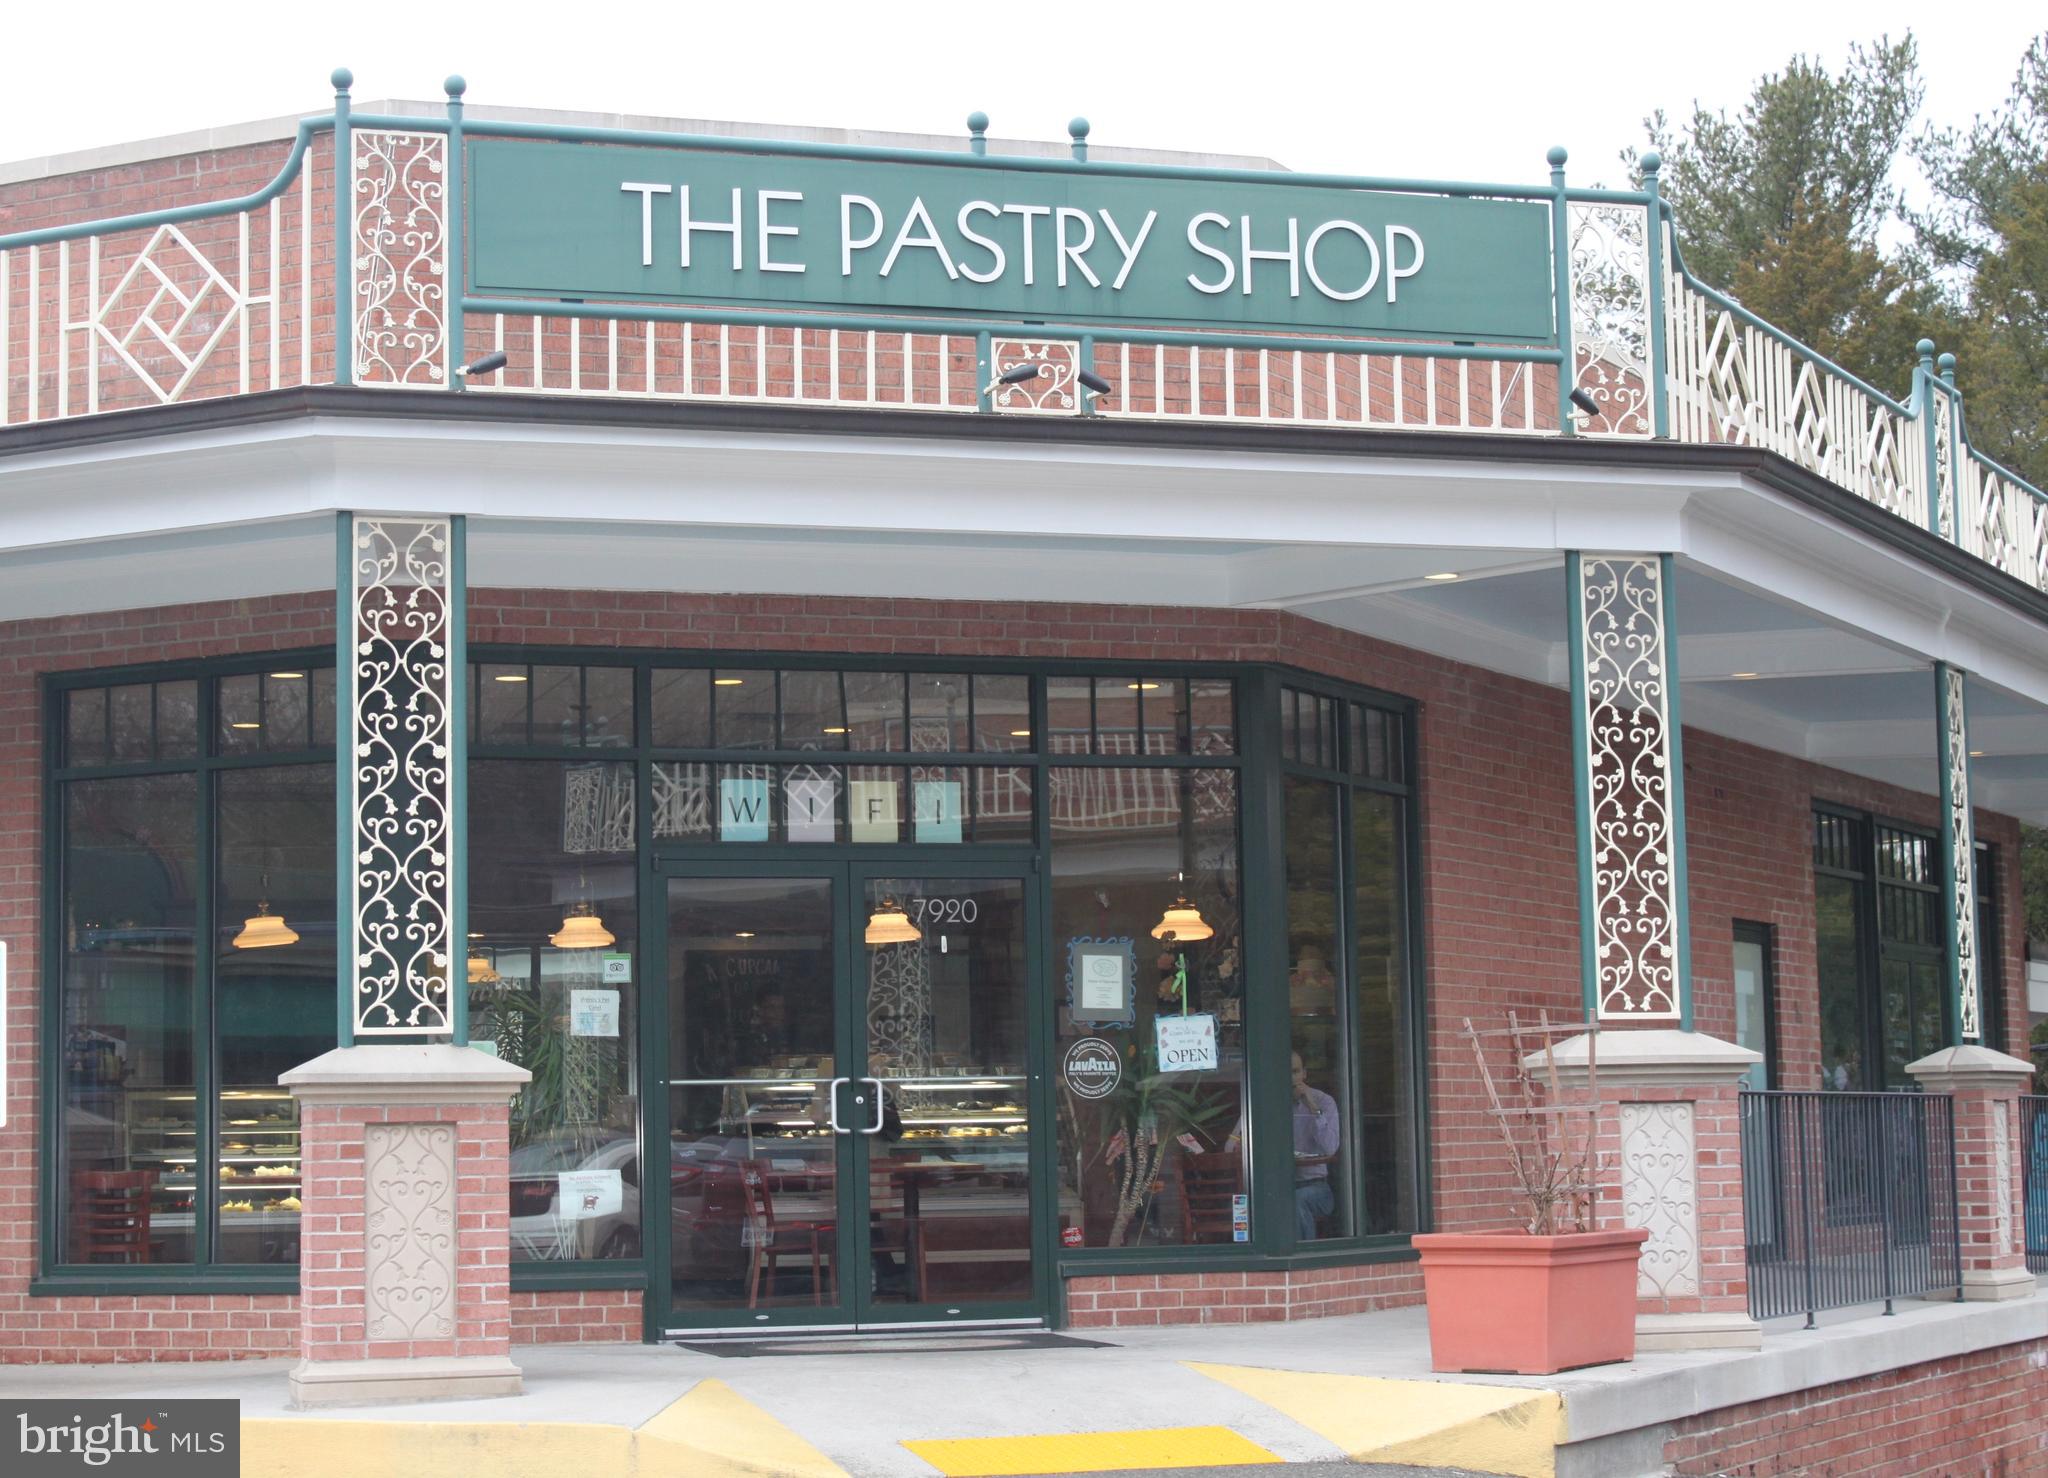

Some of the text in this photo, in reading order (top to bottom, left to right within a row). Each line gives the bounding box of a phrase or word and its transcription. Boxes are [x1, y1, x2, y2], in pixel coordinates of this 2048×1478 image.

[620, 181, 1425, 303] THE PASTRY SHOP
[912, 899, 978, 923] 7920
[1068, 1057, 1117, 1071] LAVAZZA
[1166, 1048, 1209, 1064] OPEN
